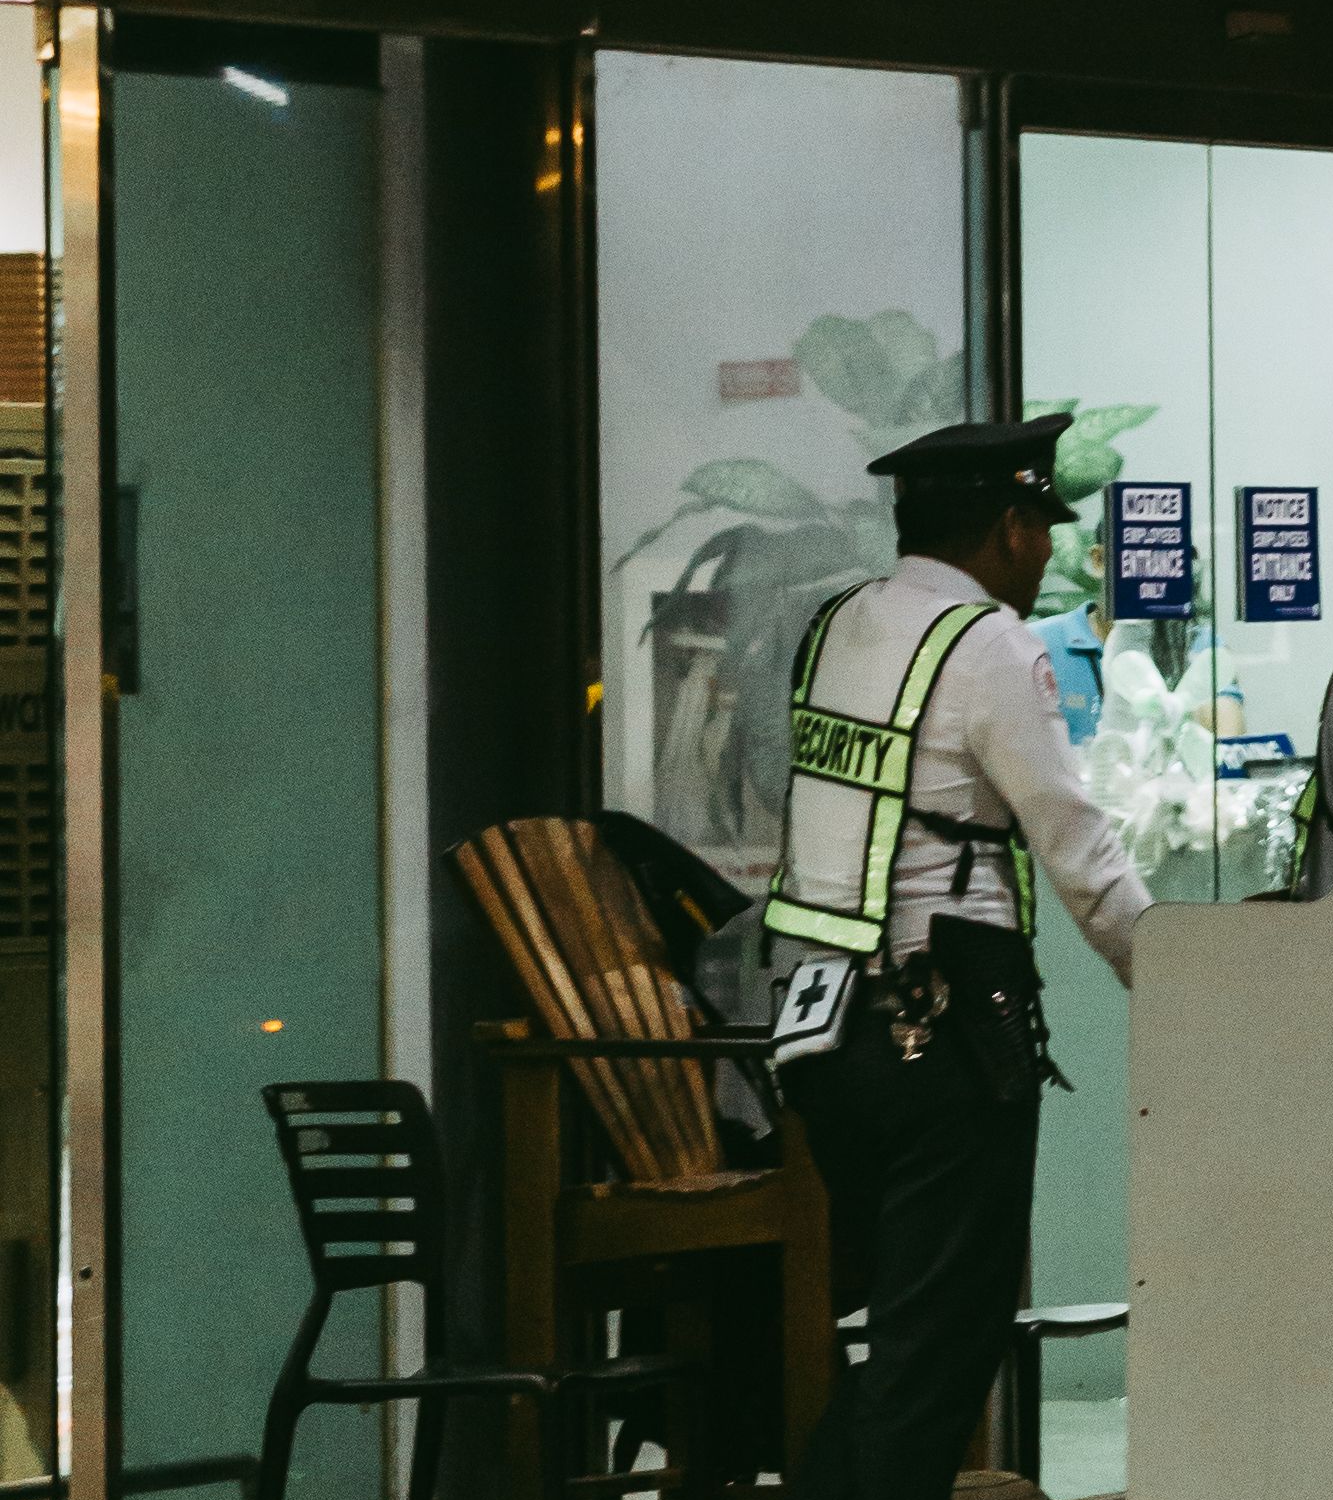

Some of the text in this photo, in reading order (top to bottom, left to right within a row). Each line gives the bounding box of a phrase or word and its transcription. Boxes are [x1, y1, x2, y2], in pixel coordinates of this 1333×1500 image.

[1126, 492, 1179, 514] NOTICE
[1255, 497, 1306, 518] NOTICE
[1121, 549, 1185, 579] ENTRANCE
[1251, 552, 1313, 581] ENTRANCE
[797, 715, 895, 783] SECURITY
